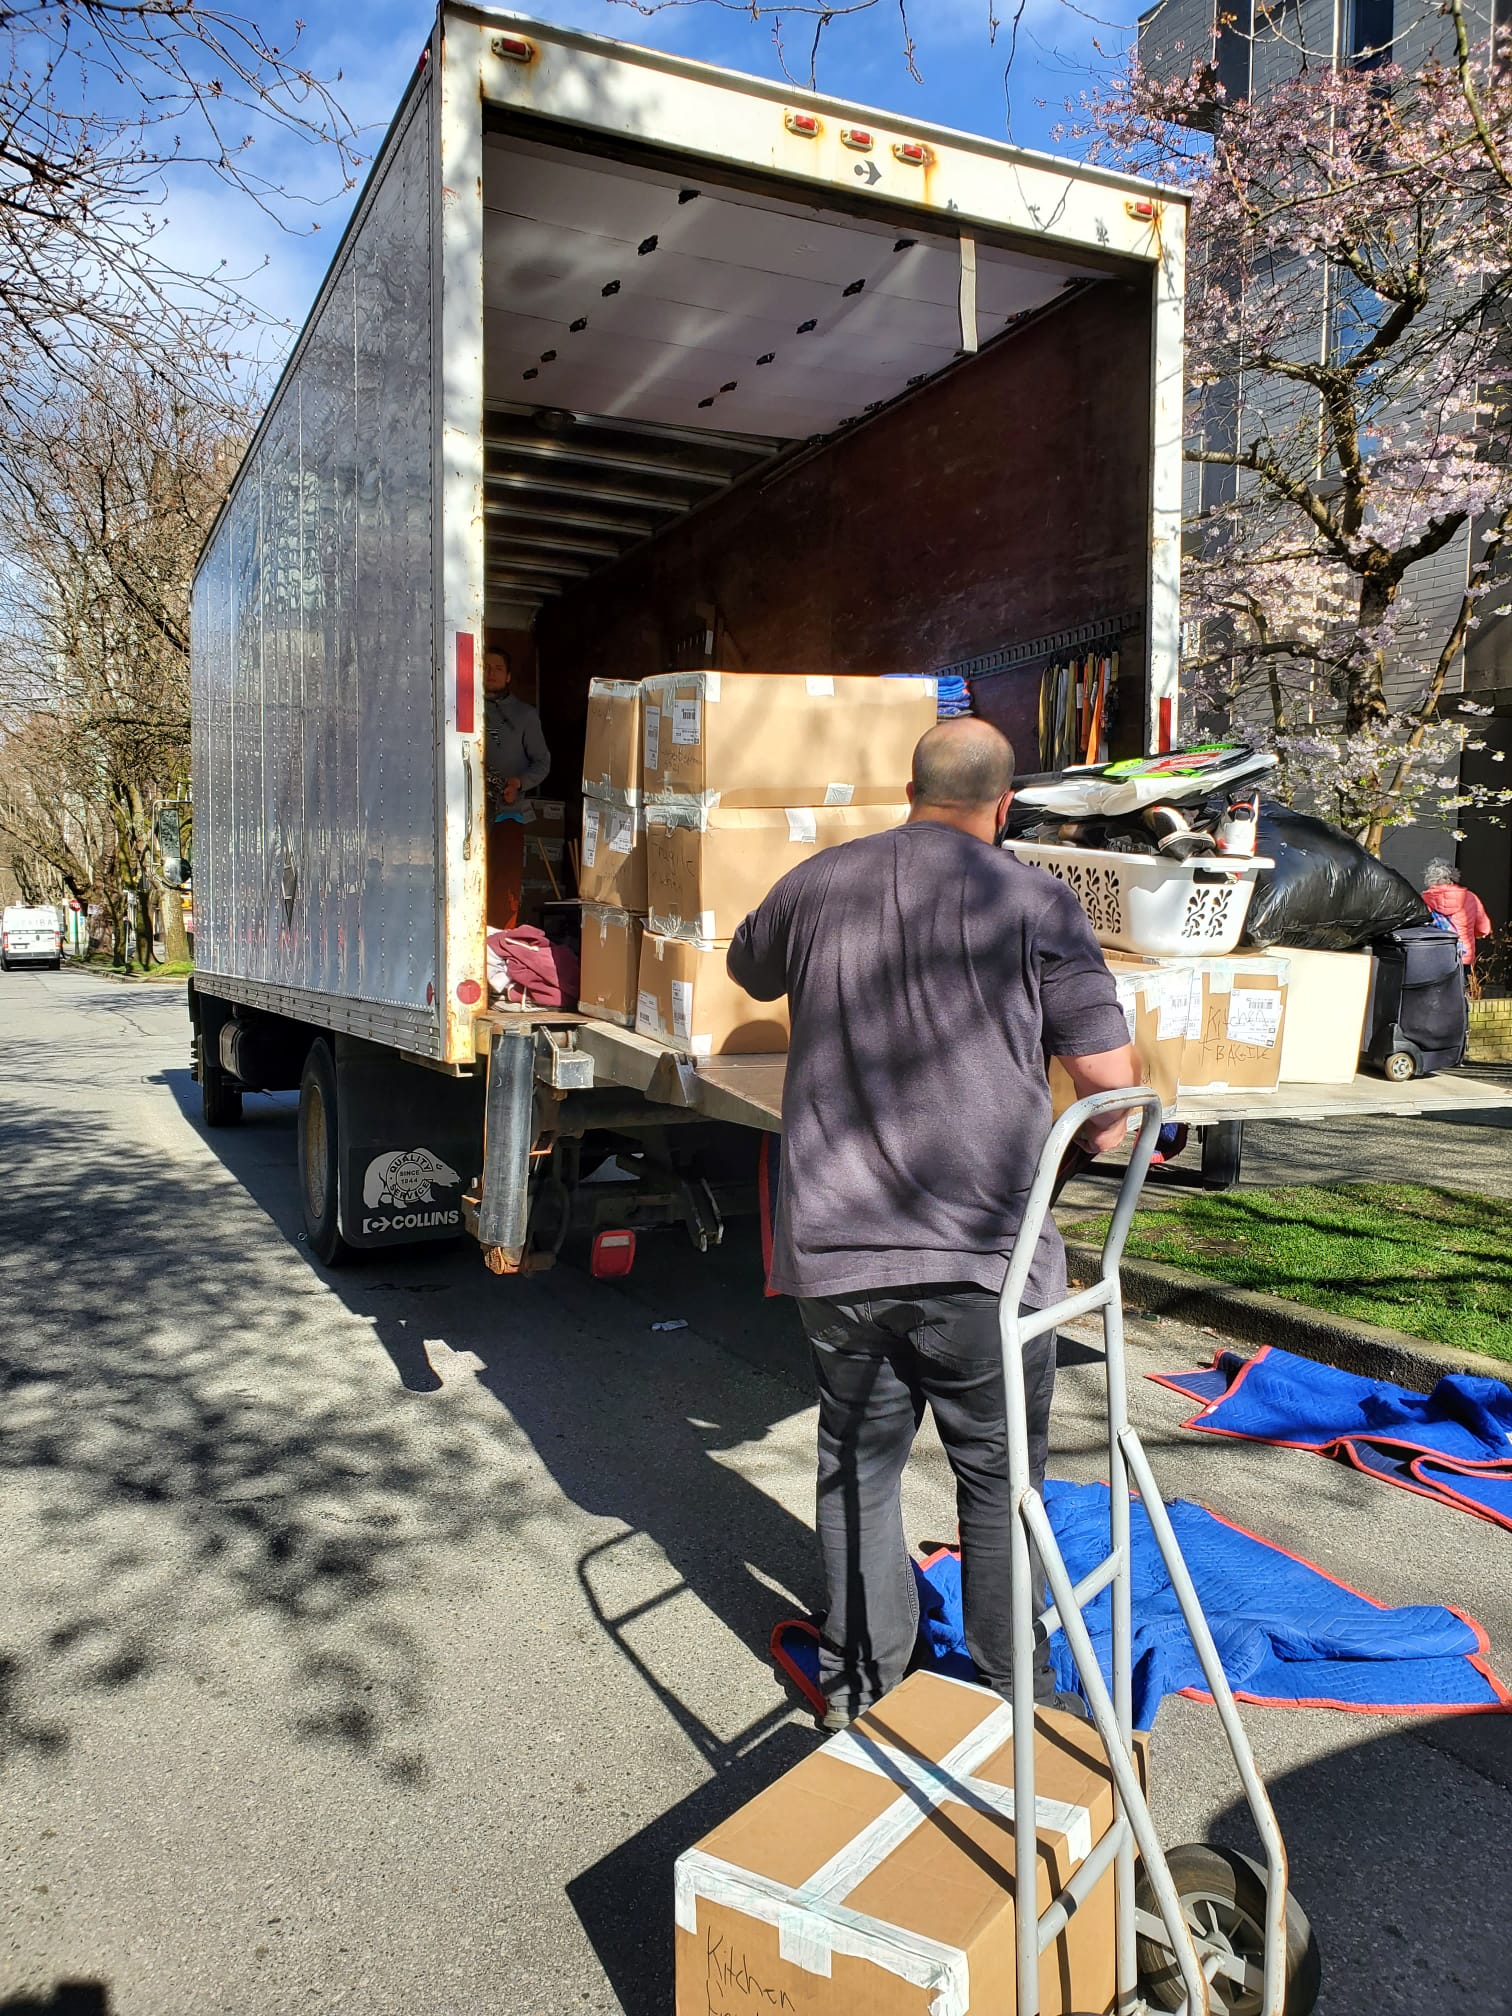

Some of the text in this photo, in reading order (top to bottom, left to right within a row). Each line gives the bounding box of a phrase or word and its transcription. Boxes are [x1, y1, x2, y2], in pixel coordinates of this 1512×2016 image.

[390, 1154, 431, 1173] QUALITY
[390, 1181, 430, 1200] SERVICE
[391, 1210, 459, 1230] COLLINS
